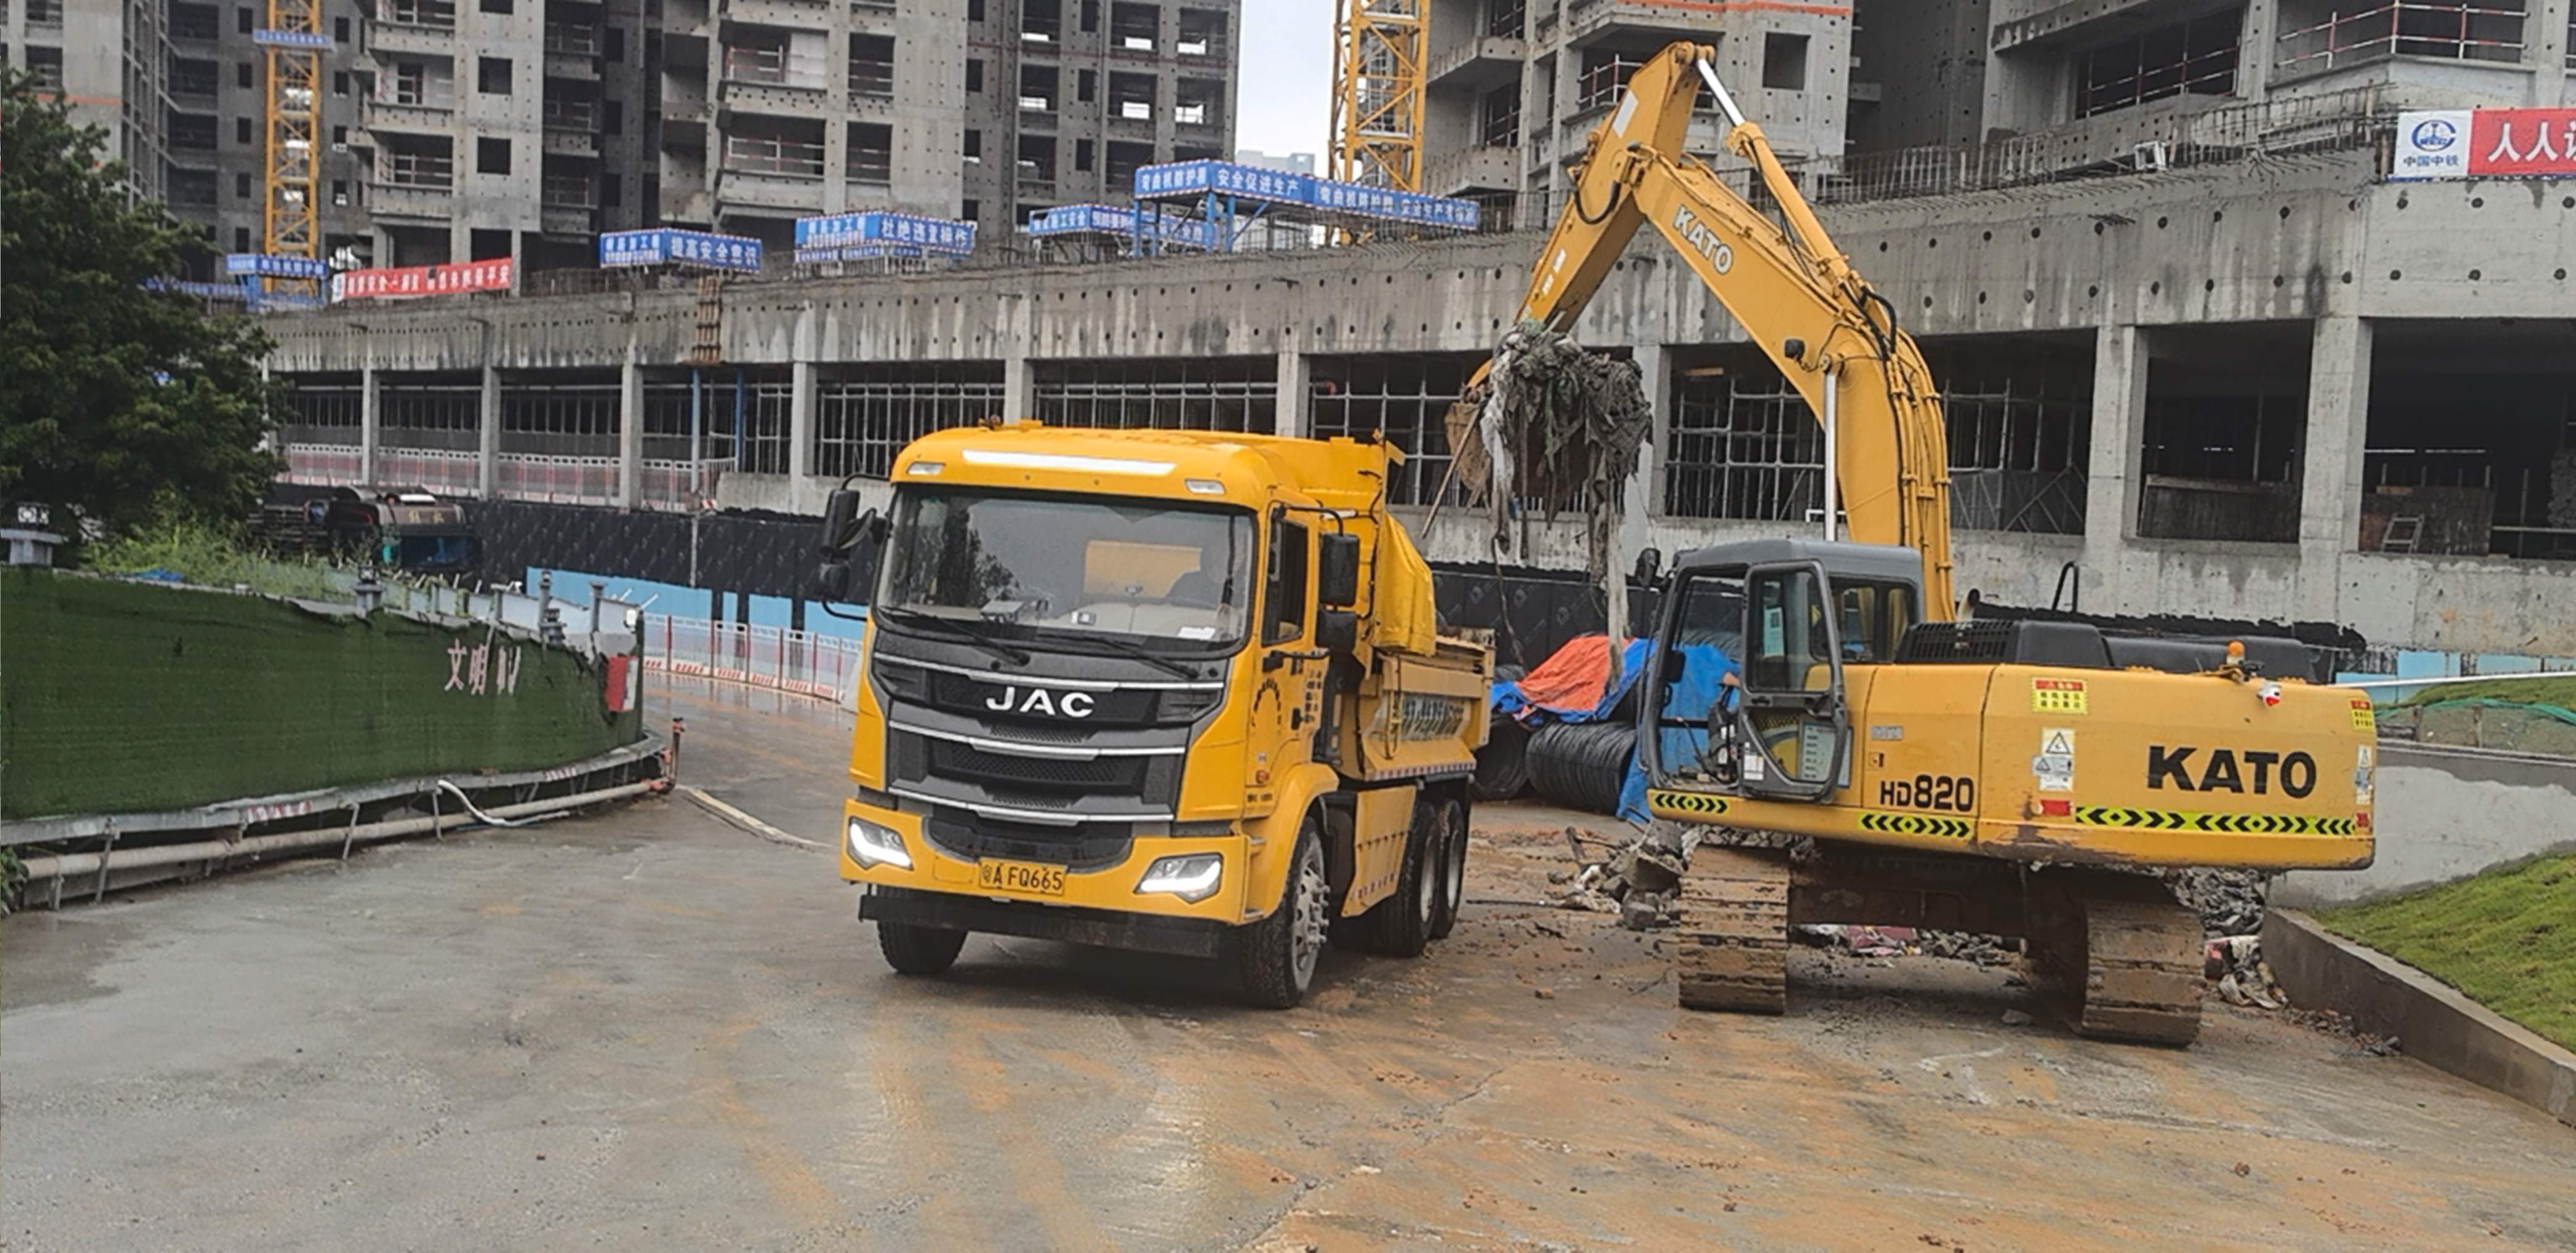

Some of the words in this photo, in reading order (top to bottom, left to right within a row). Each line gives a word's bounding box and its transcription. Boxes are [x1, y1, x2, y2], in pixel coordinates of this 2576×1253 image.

[2403, 154, 2458, 167] 中国中铁
[1673, 204, 1734, 275] KATO
[986, 686, 1095, 718] JAC
[2147, 745, 2317, 799] KATO
[1880, 774, 1974, 812] HD820
